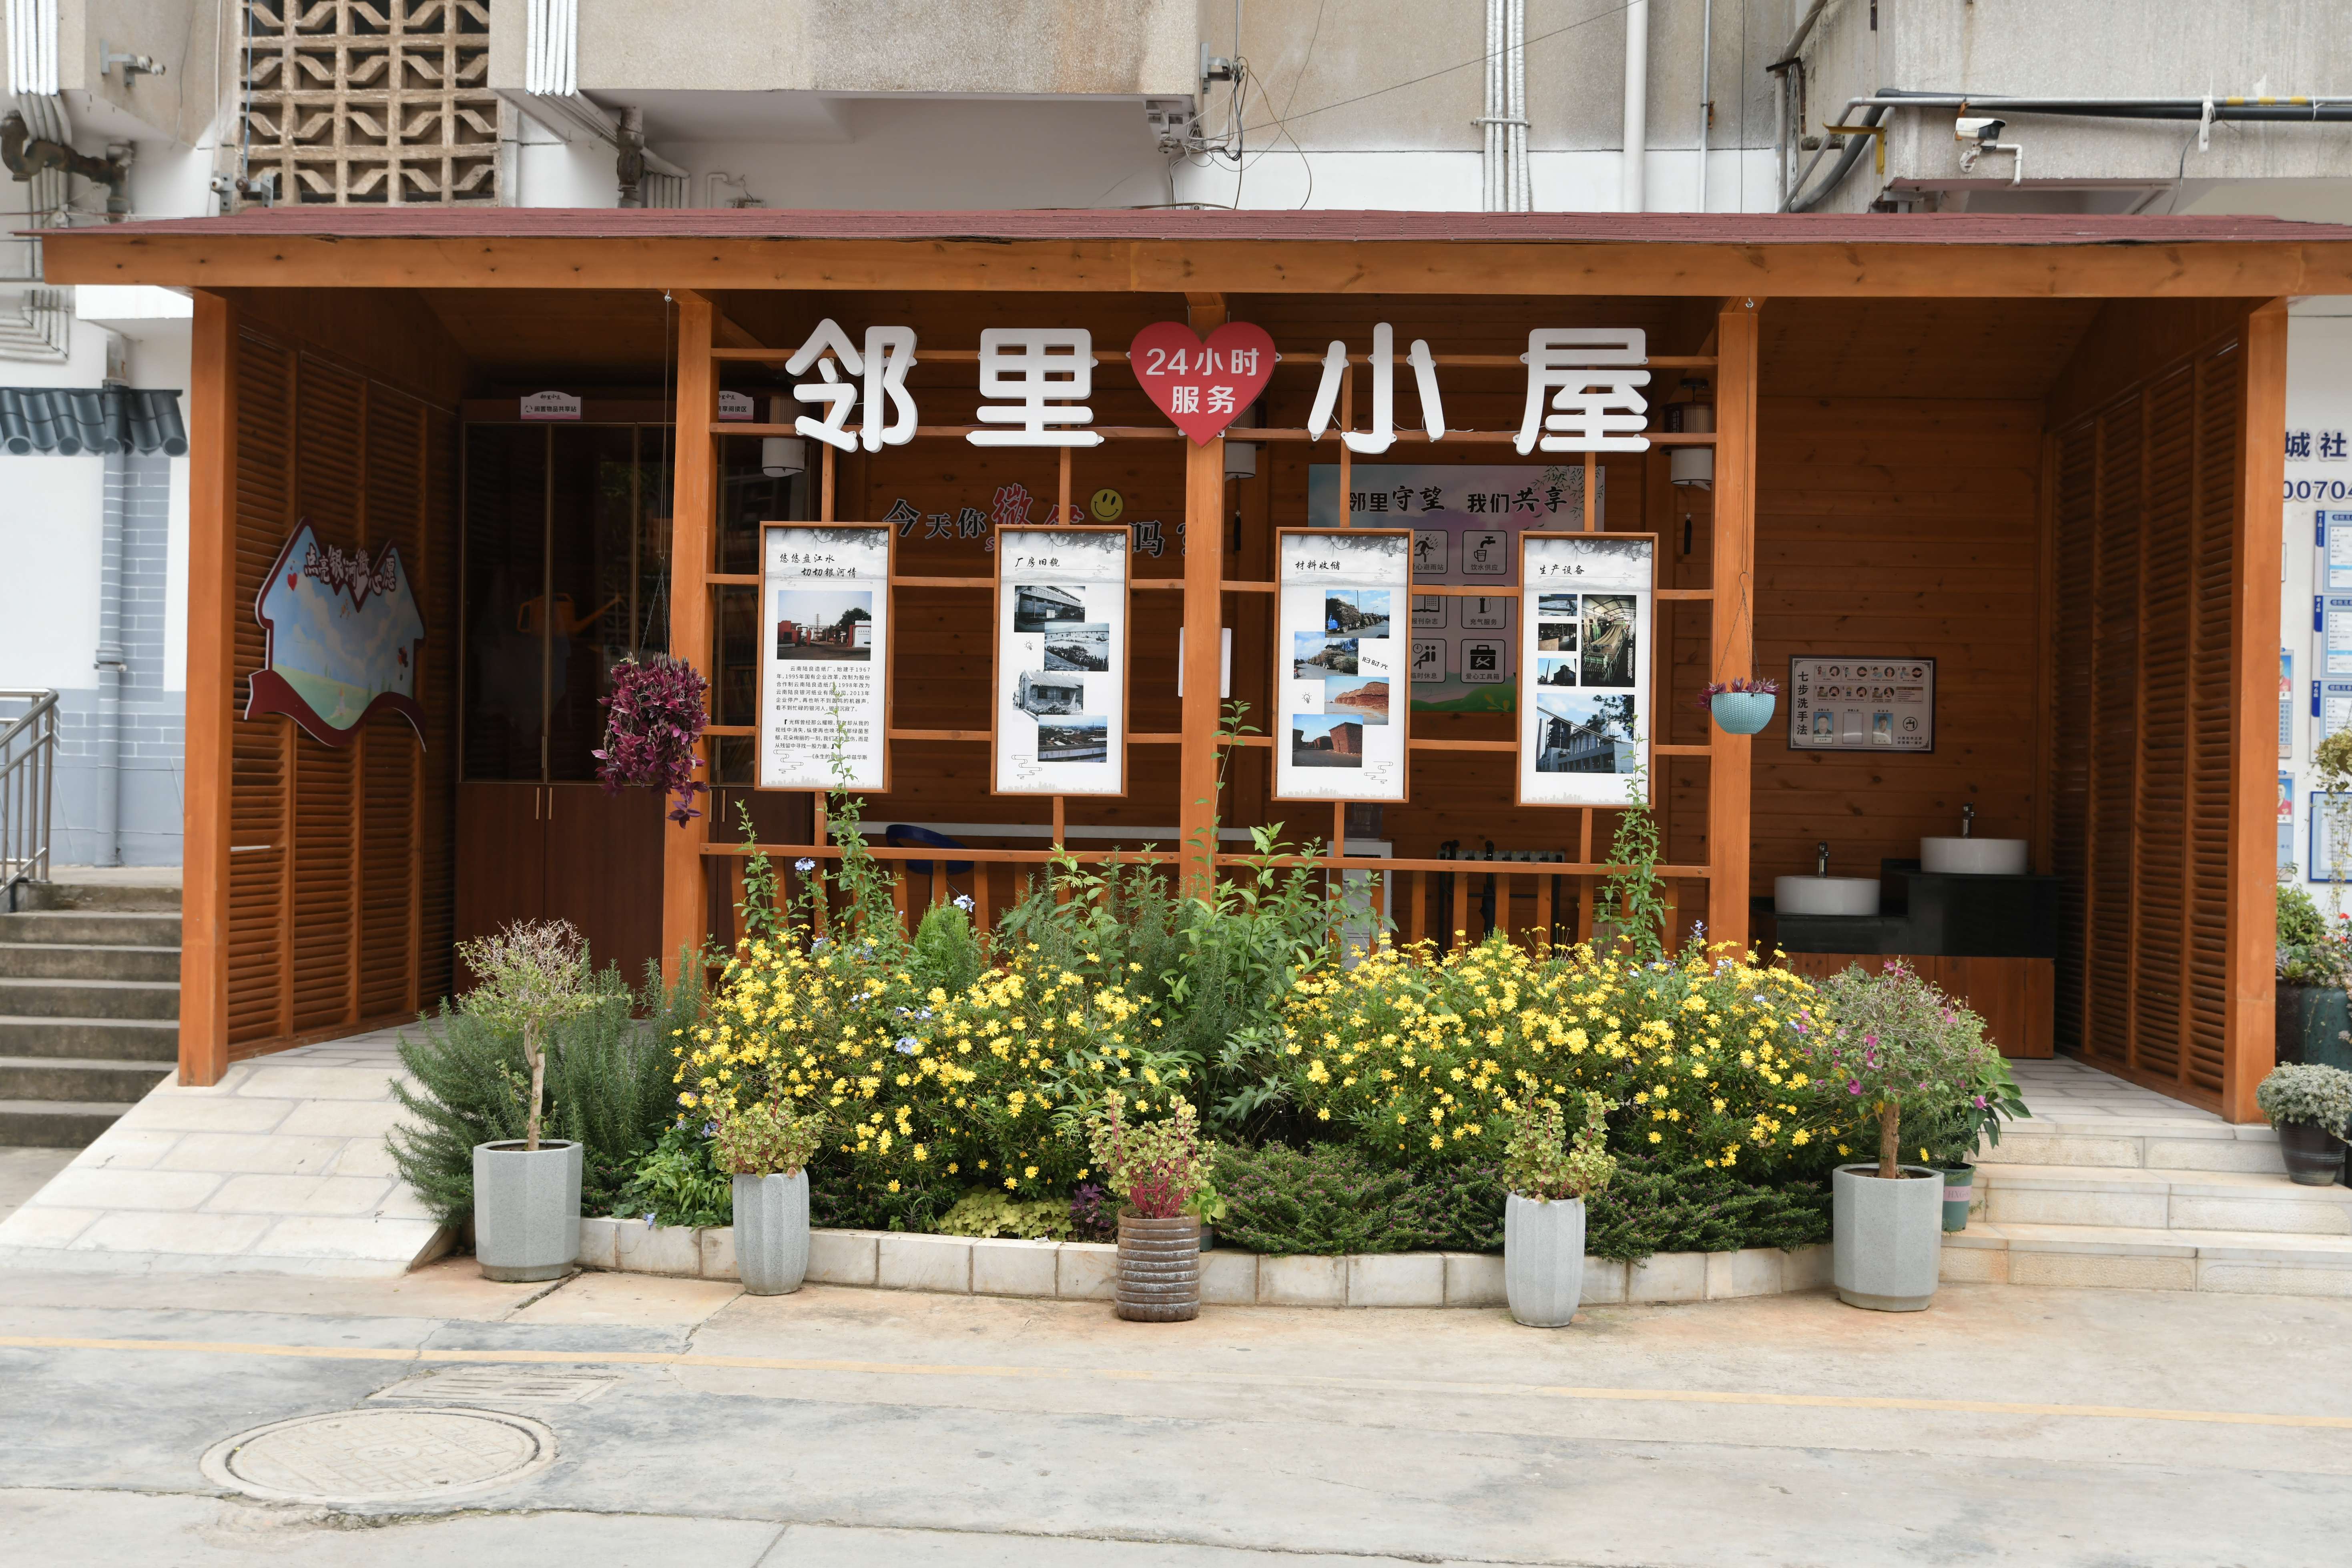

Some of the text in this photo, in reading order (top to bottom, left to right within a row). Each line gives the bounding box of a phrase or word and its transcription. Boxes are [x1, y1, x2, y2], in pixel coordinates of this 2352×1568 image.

[1146, 348, 1260, 376] 24小时
[785, 318, 1651, 455] 邻里 小屋
[1171, 385, 1236, 414] 服务
[1350, 485, 1568, 513] 邻里守望 我们共享
[780, 553, 835, 563] 悠悠盘江水
[1015, 557, 1060, 567] 厂房旧貌
[801, 567, 857, 578] 切切银河情
[1295, 560, 1341, 571] 材料收储
[1539, 564, 1585, 575] 生产设备
[1362, 656, 1389, 670] 旧时光
[1796, 671, 1809, 736] 七步洗手法
